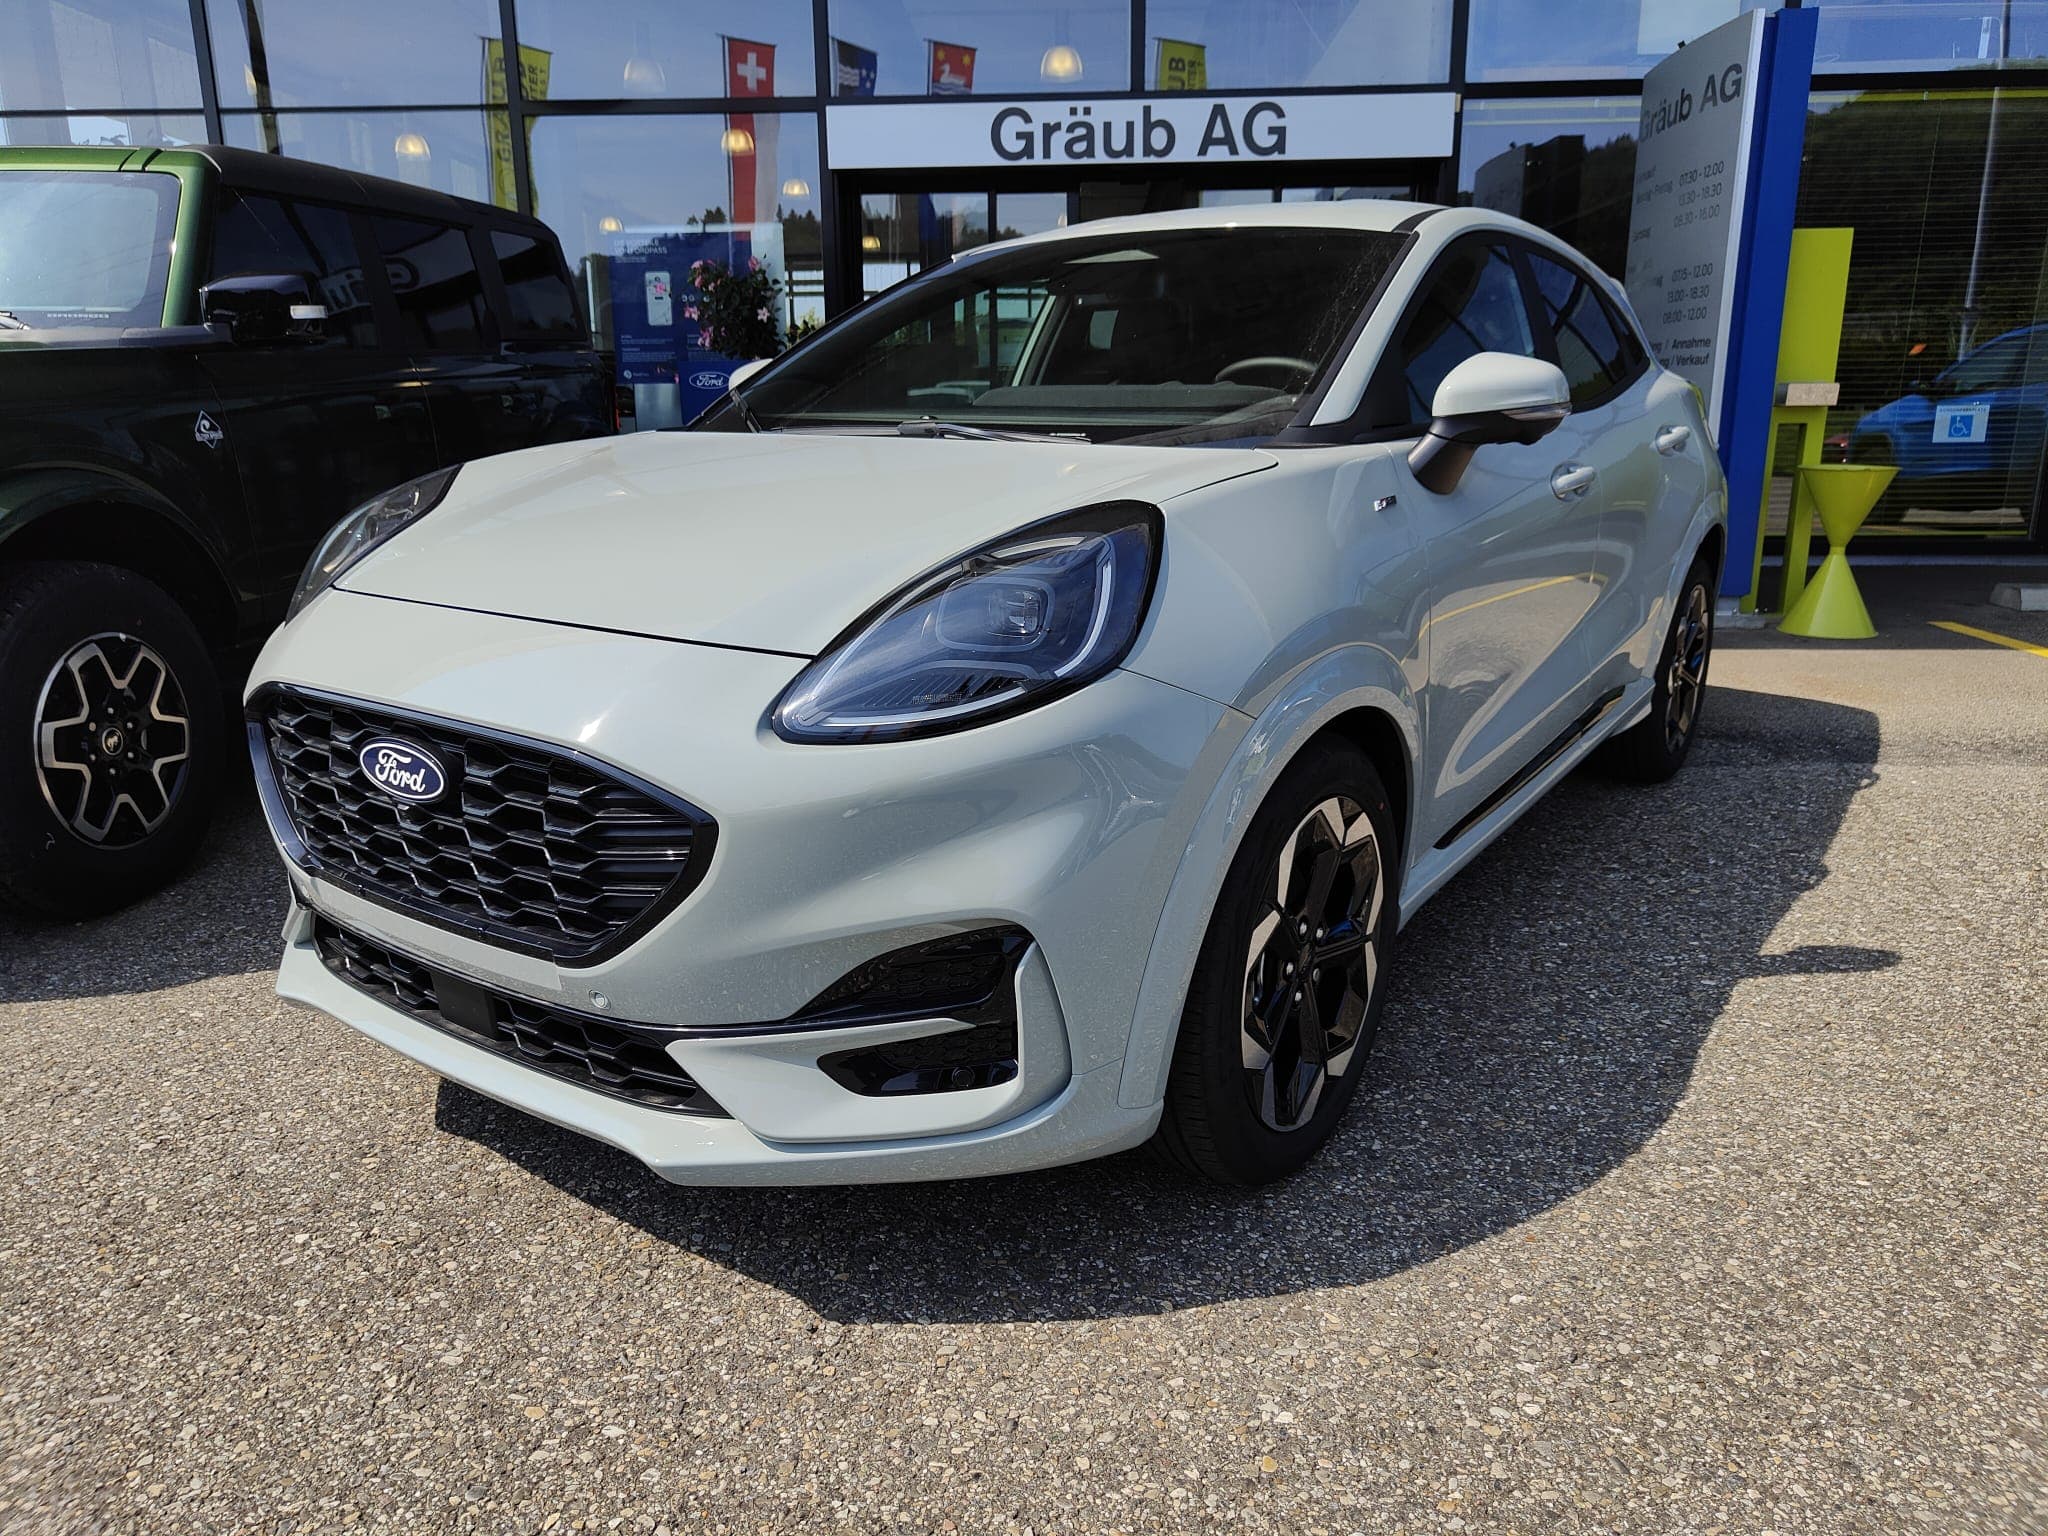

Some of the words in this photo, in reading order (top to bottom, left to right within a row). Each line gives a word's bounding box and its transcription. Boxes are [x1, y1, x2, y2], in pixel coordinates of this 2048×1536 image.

[1699, 63, 1743, 114] AG
[990, 105, 1176, 161] Gräub
[1197, 101, 1287, 156] AG
[1672, 337, 1712, 350] Annahme
[1676, 352, 1710, 367] Verkauf
[697, 375, 723, 386] Ford
[375, 749, 426, 793] Ford
